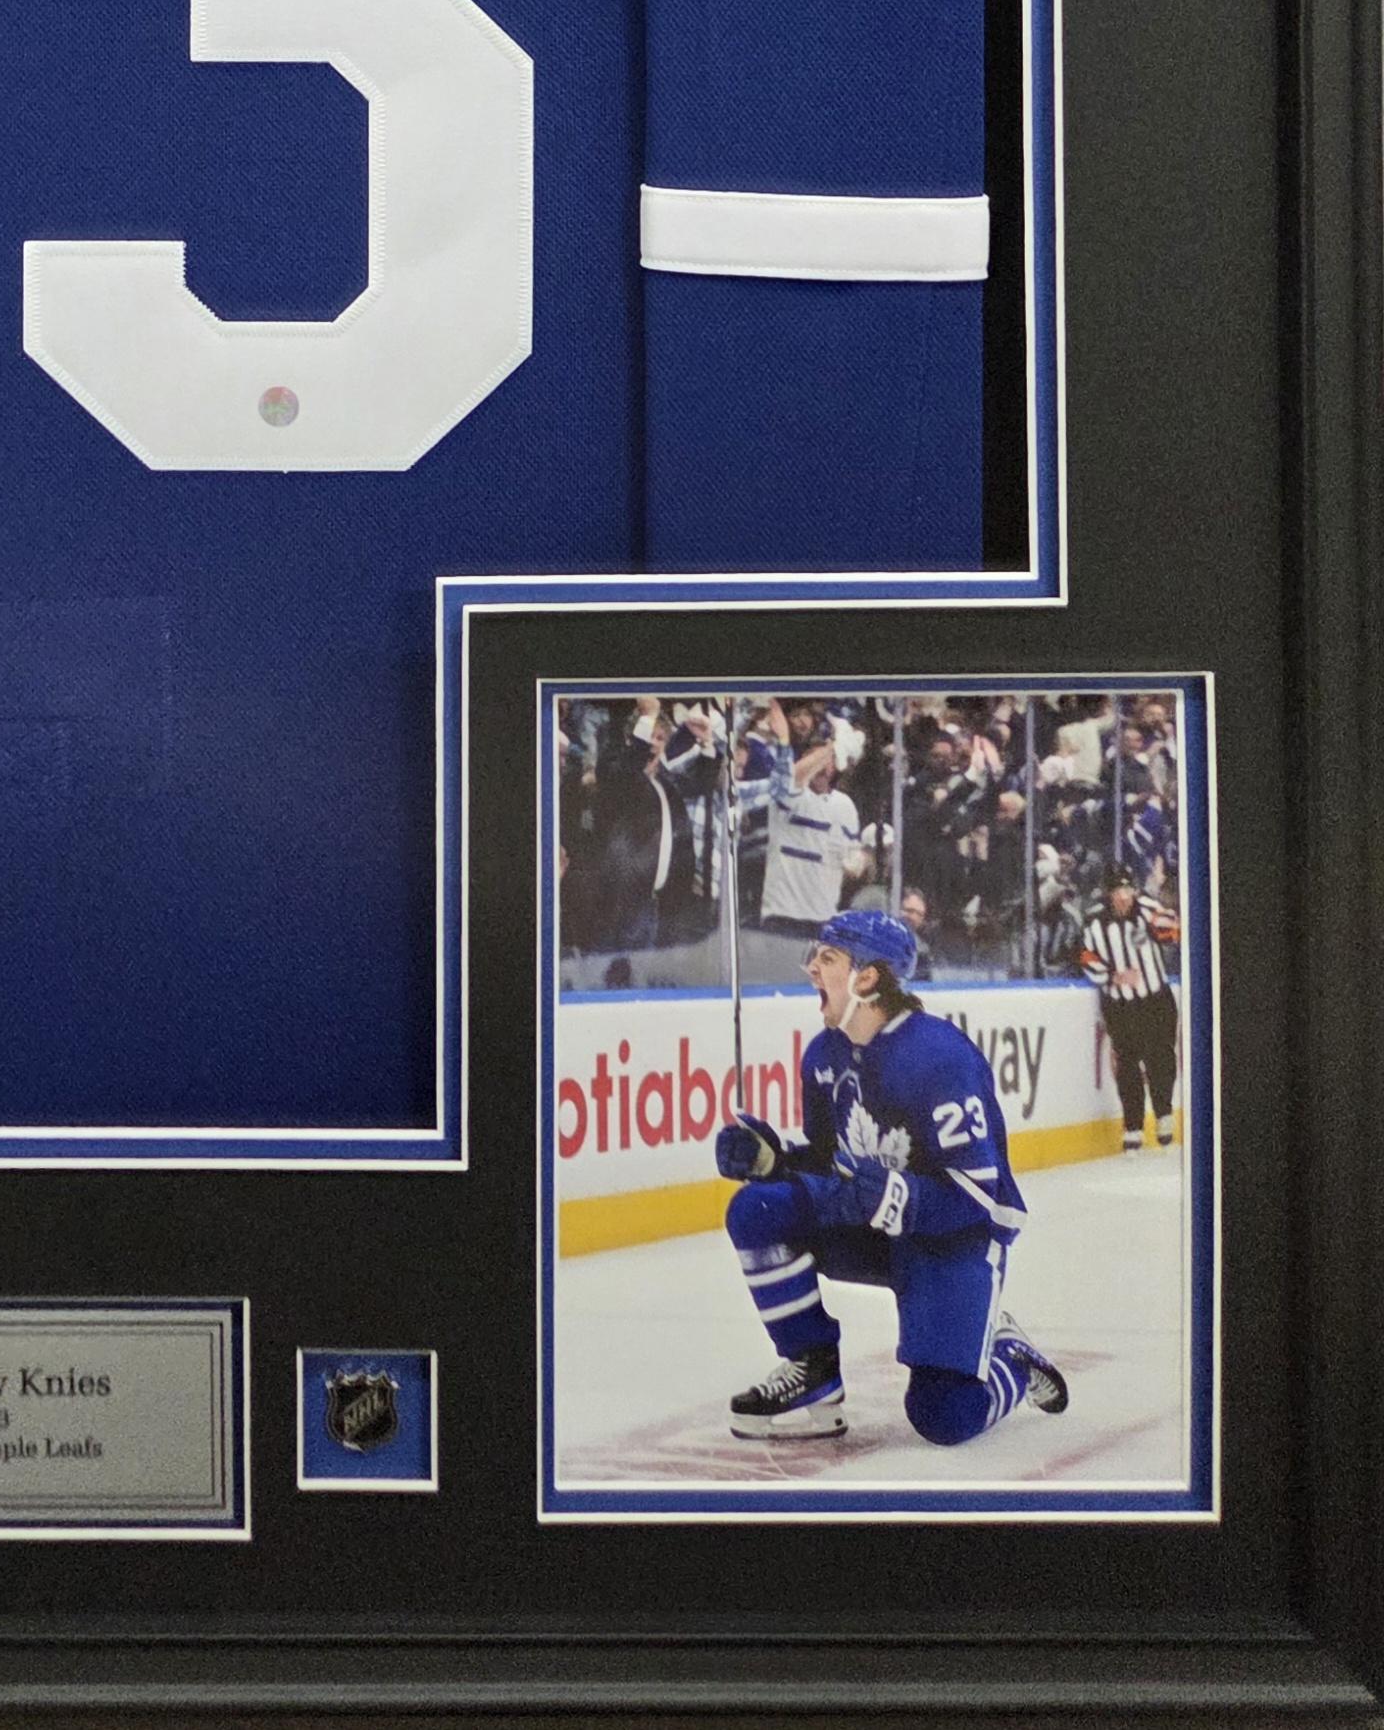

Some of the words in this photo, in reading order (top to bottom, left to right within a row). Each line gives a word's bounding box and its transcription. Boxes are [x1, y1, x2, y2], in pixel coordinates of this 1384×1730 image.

[932, 1095, 989, 1149] 23
[18, 1366, 112, 1398] Knies
[44, 1436, 104, 1459] Leafs
